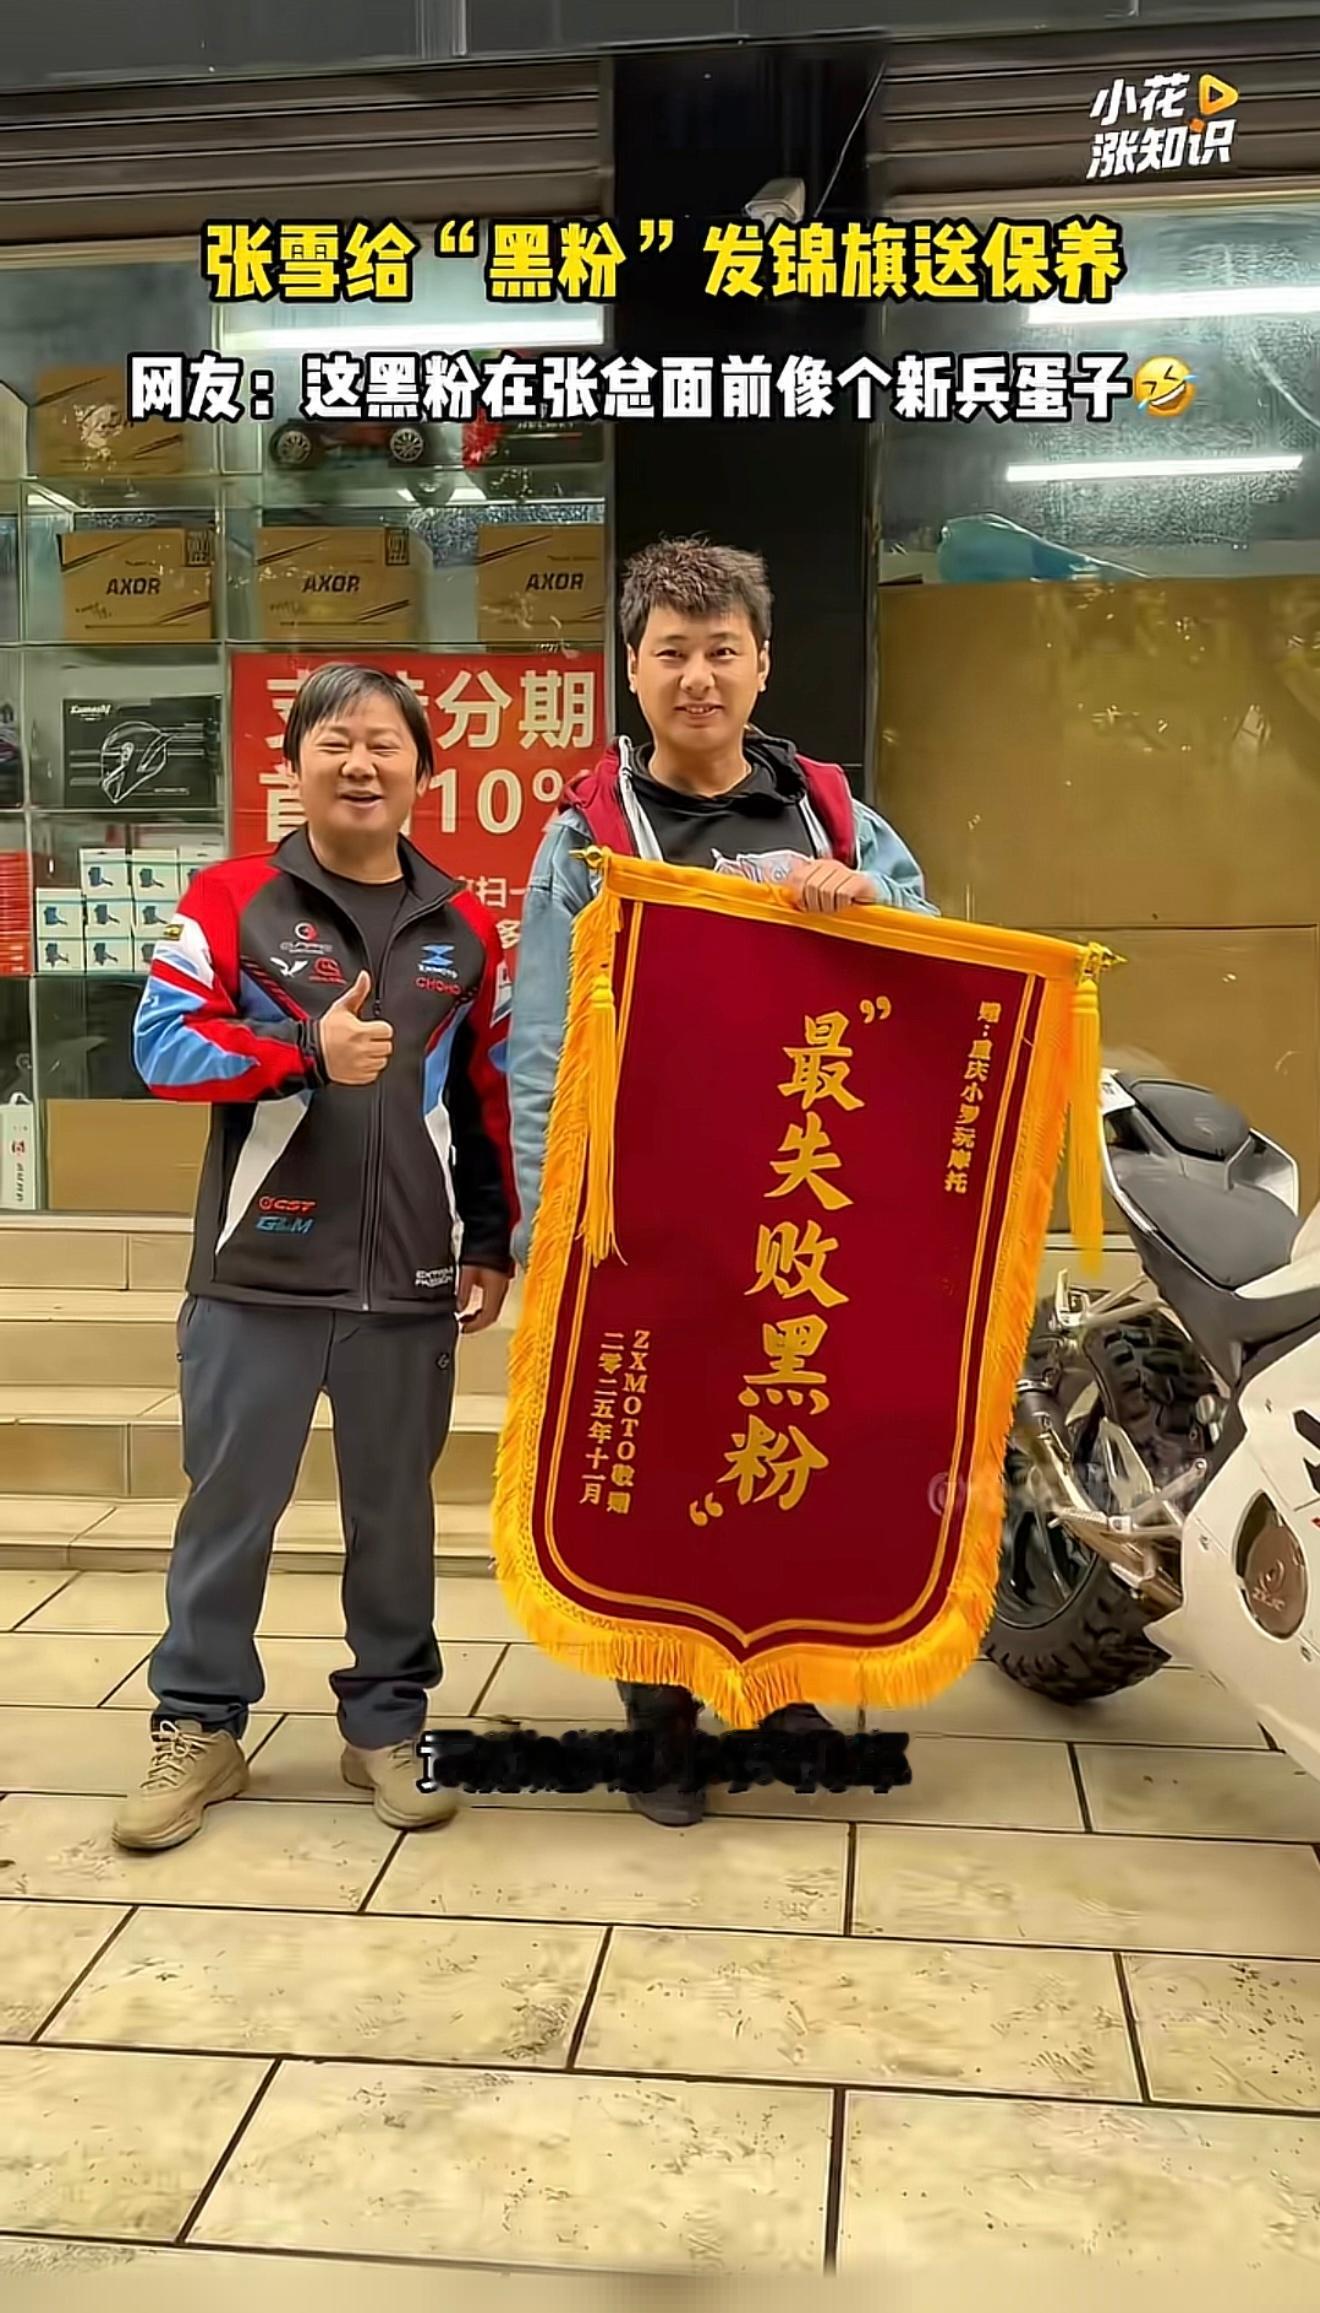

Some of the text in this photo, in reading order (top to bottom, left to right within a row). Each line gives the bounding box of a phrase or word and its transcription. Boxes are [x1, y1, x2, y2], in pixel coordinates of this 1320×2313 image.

[106, 577, 161, 595] AXOR
[302, 574, 361, 593] AXOR
[525, 572, 584, 592] AXOR
